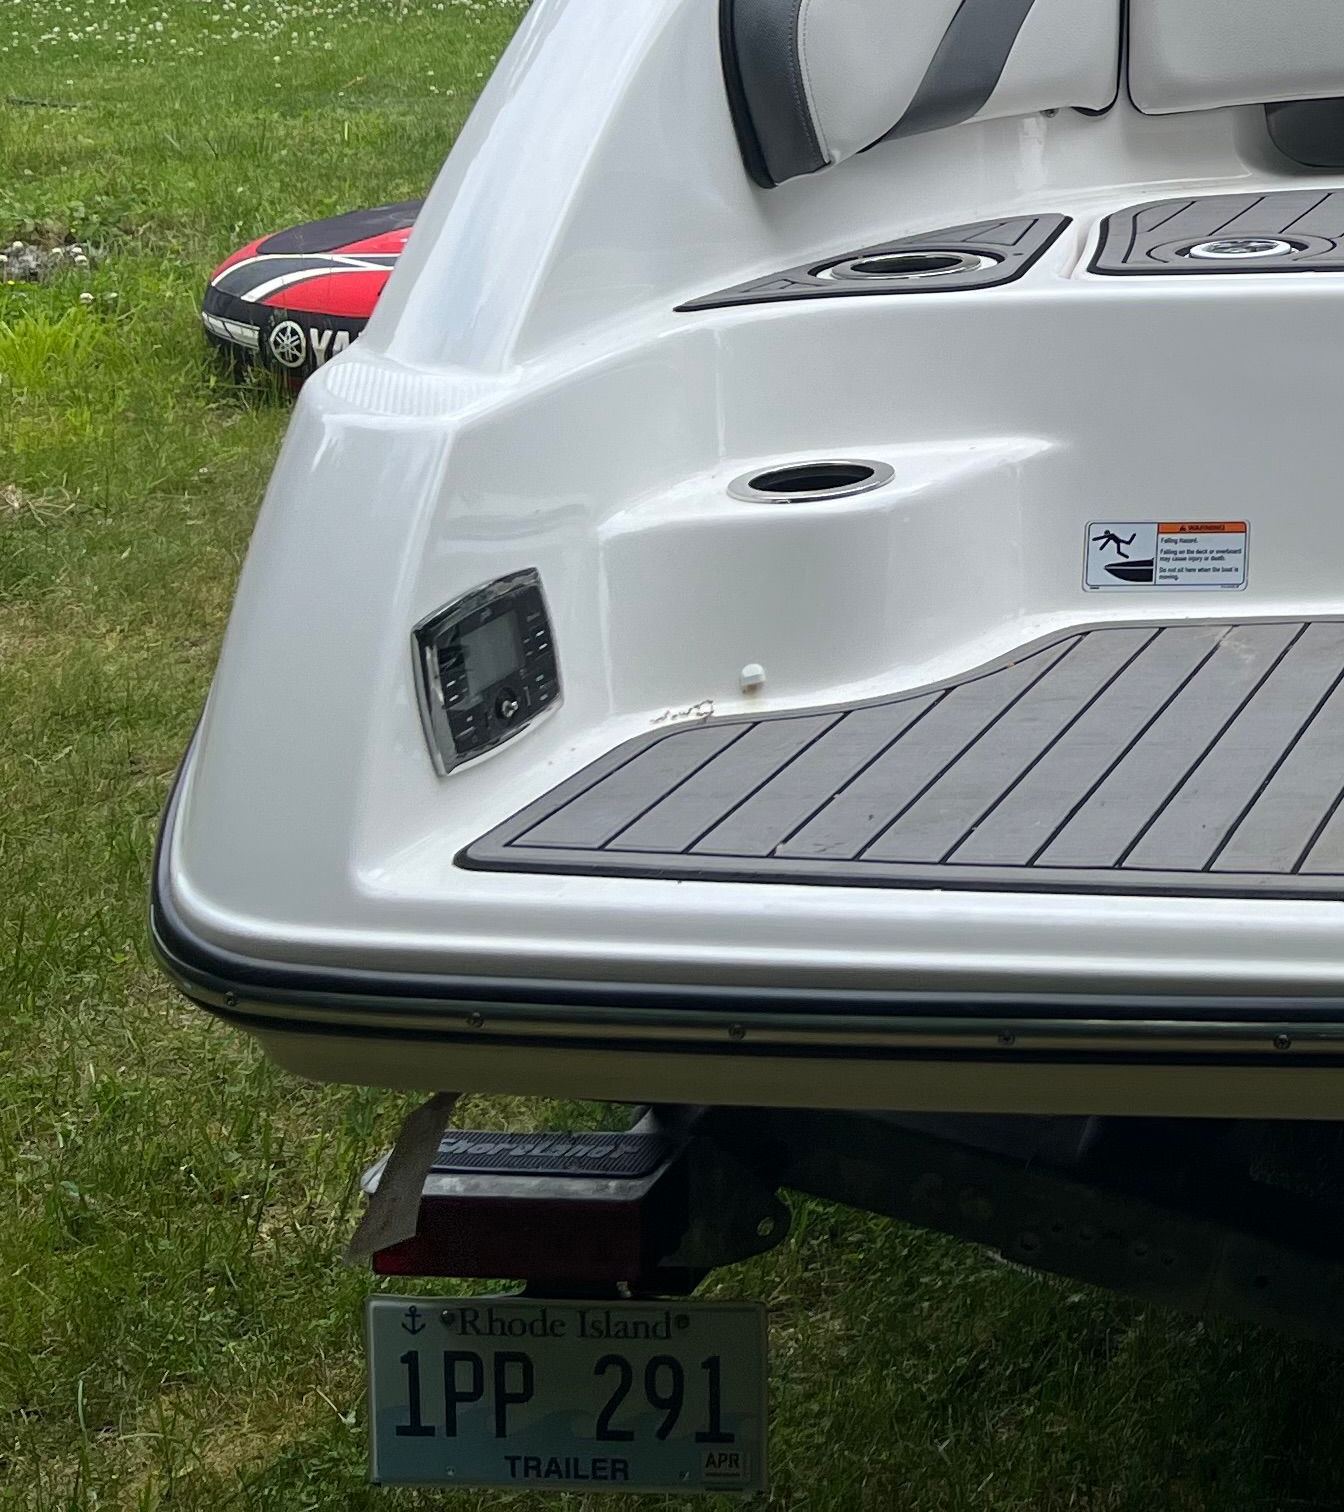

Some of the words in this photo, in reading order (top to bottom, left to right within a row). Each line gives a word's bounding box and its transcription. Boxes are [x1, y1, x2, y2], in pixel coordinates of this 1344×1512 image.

[456, 1308, 566, 1338] Rhode
[577, 1308, 672, 1339] Island
[396, 1350, 535, 1438] 1PP
[594, 1353, 735, 1444] 291
[504, 1455, 630, 1481] TRAILER
[705, 1452, 740, 1468] APR
